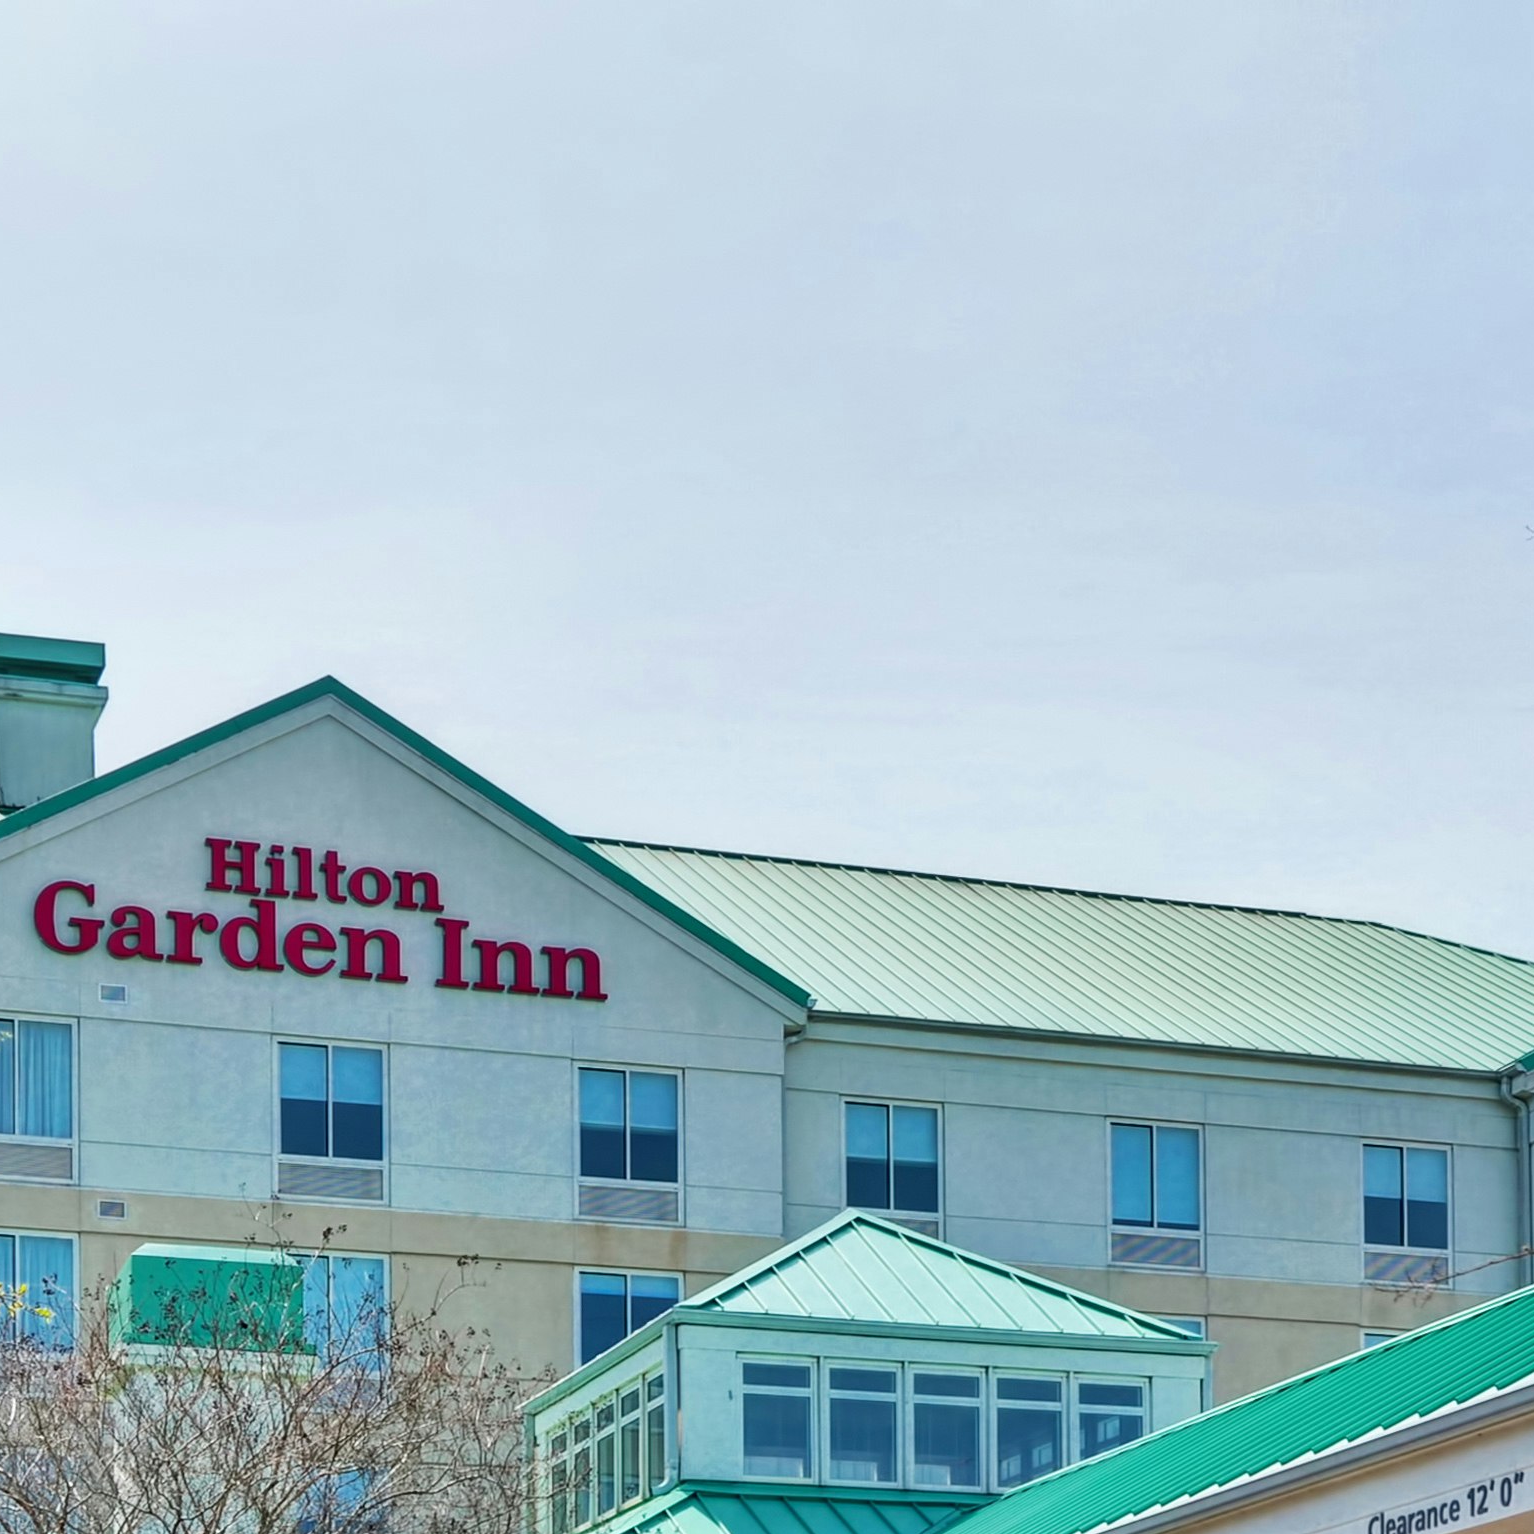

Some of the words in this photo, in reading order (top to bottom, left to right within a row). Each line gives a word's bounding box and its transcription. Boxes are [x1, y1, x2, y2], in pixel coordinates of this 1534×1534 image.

[204, 837, 444, 912] Hilton
[33, 879, 408, 984] Garden
[434, 916, 608, 1002] Inn
